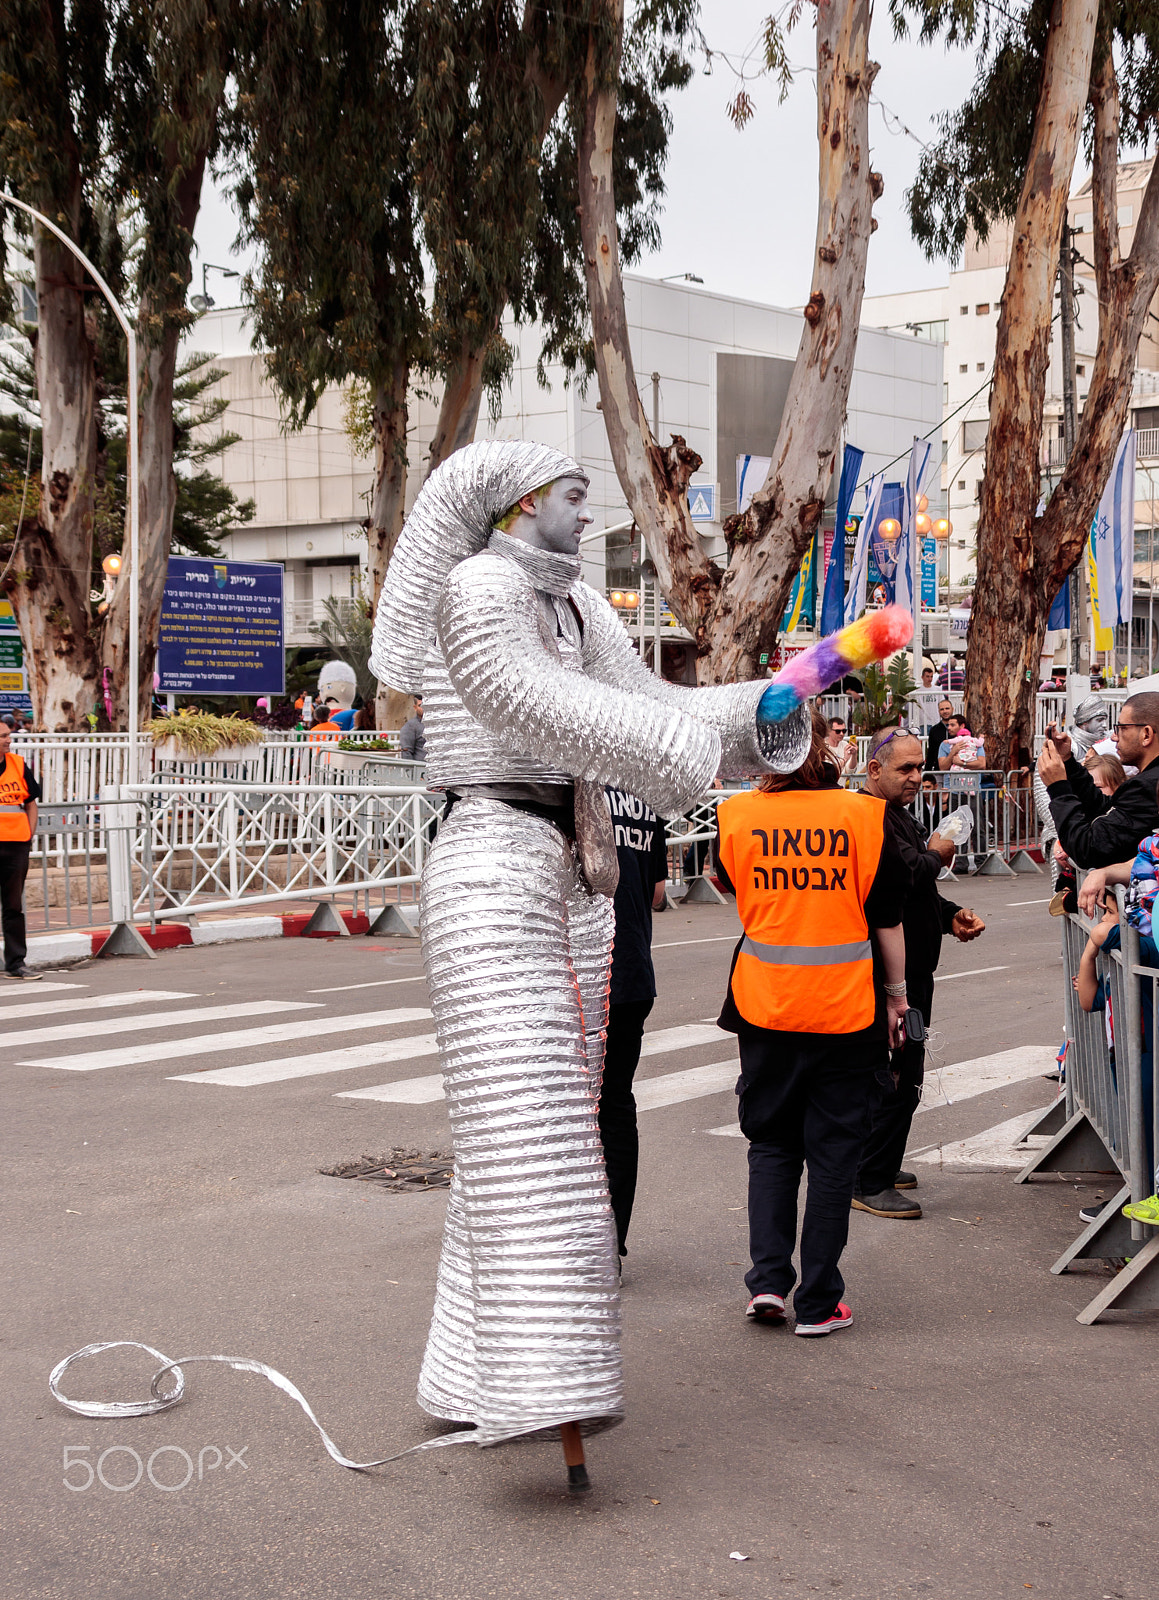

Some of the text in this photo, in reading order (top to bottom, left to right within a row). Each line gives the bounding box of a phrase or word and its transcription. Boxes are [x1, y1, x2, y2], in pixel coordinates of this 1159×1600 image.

[185, 572, 256, 587] עיריית נהריה
[614, 824, 654, 852] אבטח
[751, 828, 849, 857] מטאור
[753, 866, 847, 890] אבטחה
